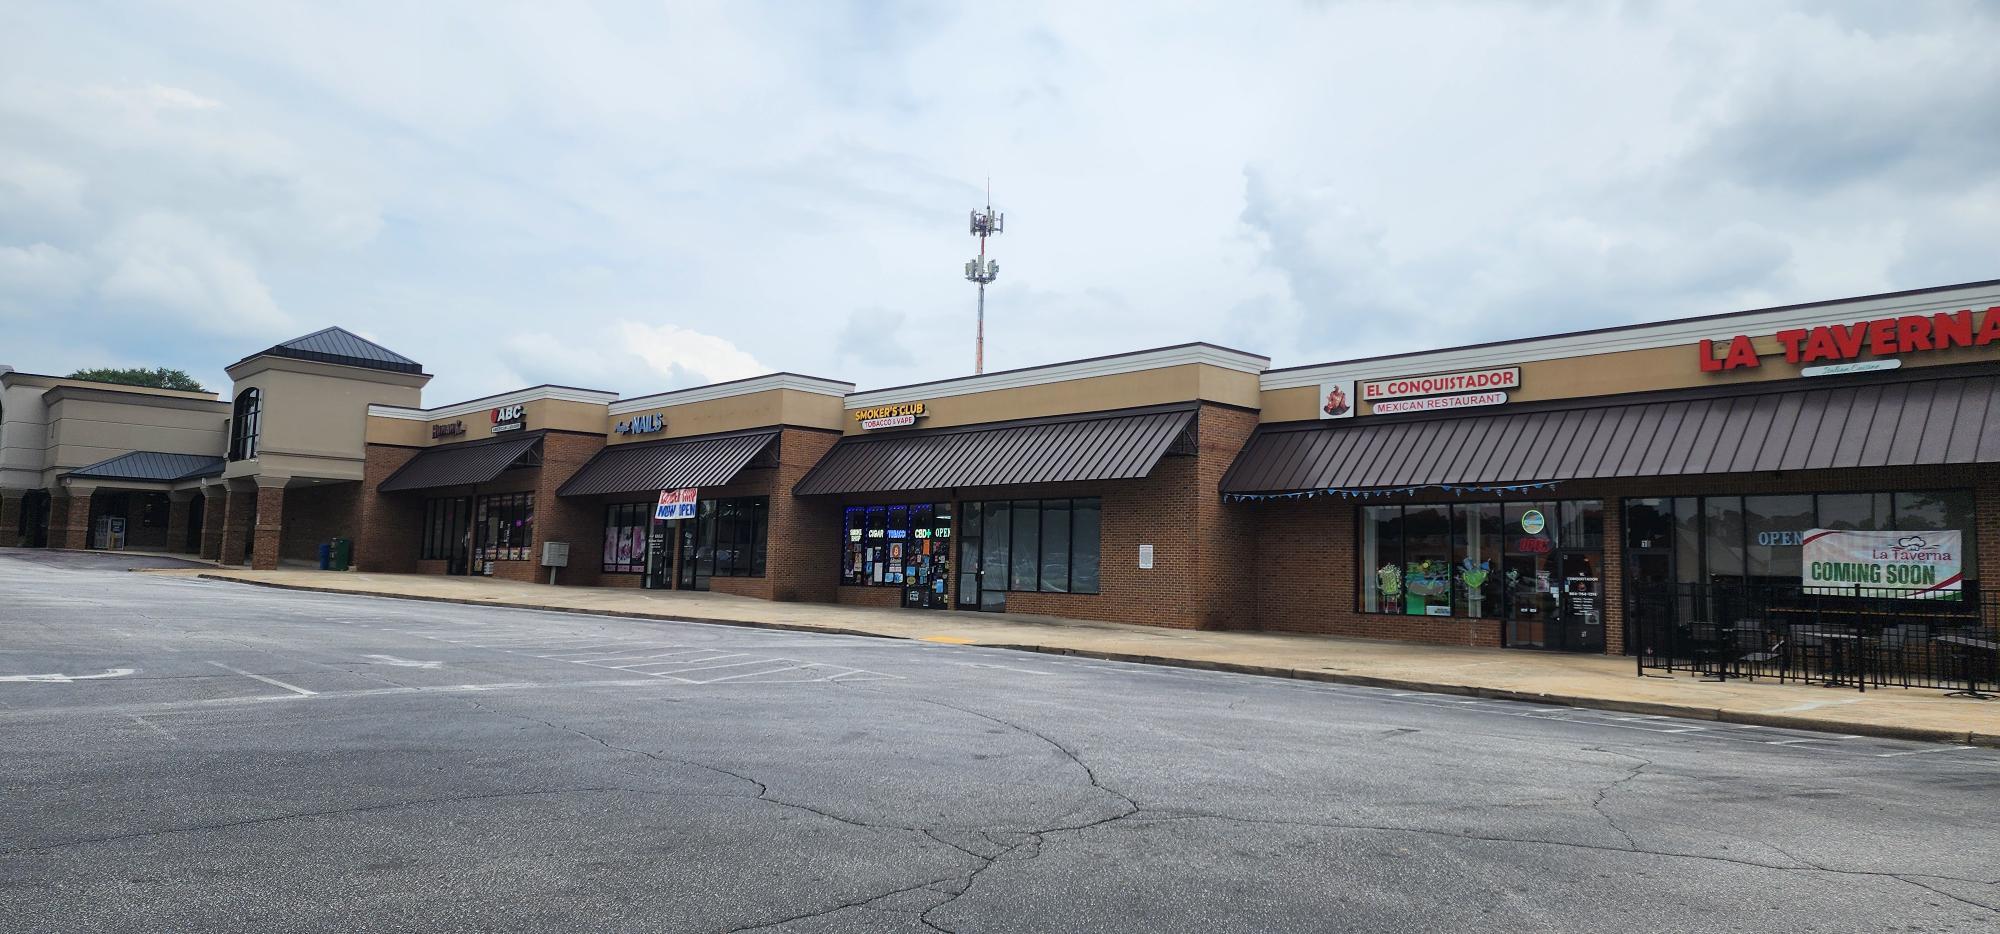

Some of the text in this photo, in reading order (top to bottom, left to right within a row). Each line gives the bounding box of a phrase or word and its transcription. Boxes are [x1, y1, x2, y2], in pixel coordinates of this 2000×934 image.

[1700, 306, 2000, 372] LA TAVERNA
[1366, 371, 1514, 397] EL CONQUISTADOR
[1377, 393, 1503, 413] MEXICAN RESTAURANT
[497, 405, 521, 422] ABC
[855, 403, 923, 421] SMOKER'S CLUB
[632, 412, 663, 434] NAILS
[864, 419, 892, 428] TOBACCO
[896, 416, 912, 424] VAPE
[657, 504, 676, 518] NOW
[868, 529, 884, 538] CIGAR
[1758, 531, 1804, 546] OPEN
[1872, 548, 1952, 561] La Taverna
[1811, 561, 1936, 585] COMING SOON
